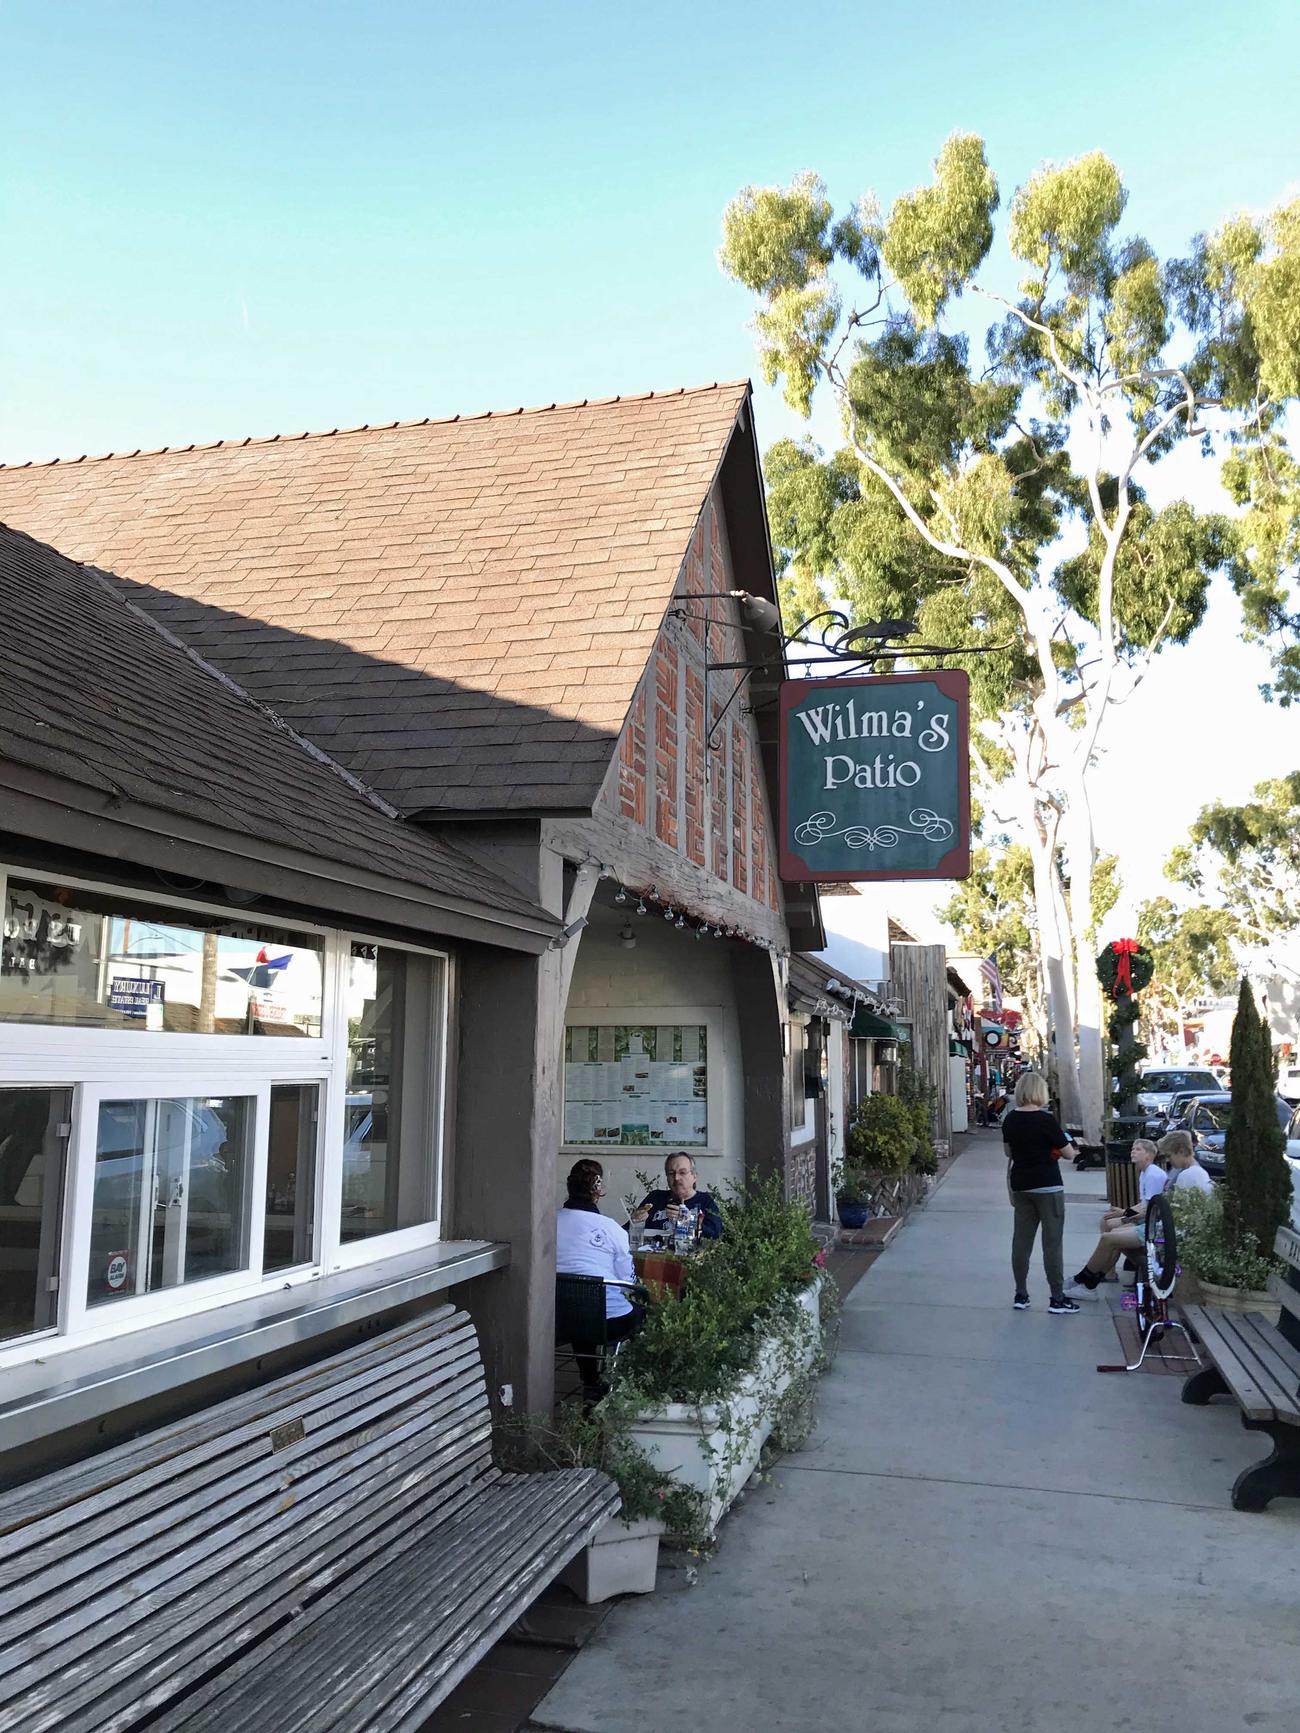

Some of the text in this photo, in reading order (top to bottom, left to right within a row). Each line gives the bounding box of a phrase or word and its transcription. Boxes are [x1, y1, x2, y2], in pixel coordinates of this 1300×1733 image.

[796, 698, 950, 752] Wilma's
[823, 754, 921, 790] Patio
[110, 1262, 125, 1273] BAY
